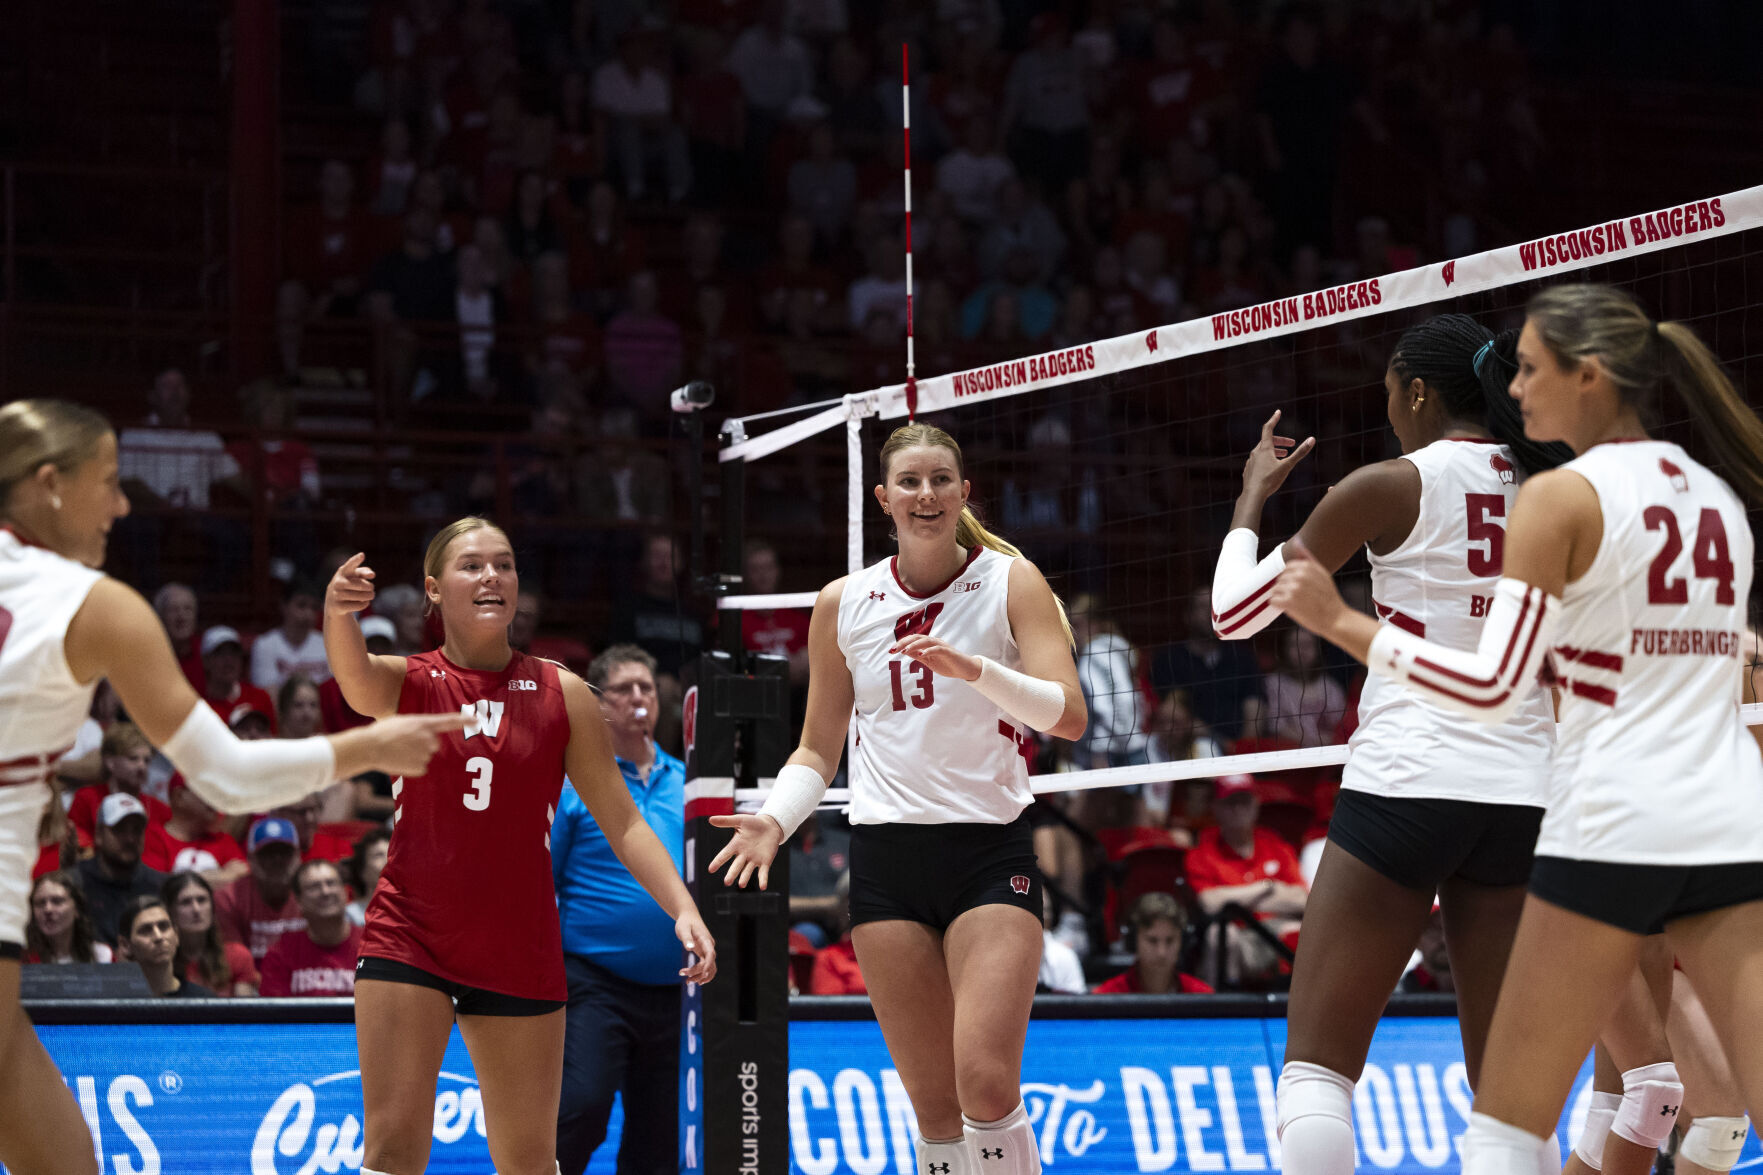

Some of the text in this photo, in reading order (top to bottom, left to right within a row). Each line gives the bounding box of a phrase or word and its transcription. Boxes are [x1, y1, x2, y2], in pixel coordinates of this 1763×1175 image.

[1519, 198, 1726, 271] WISCONSIN BADGERS
[1212, 279, 1382, 341] WISCONSIN BADGERS
[953, 345, 1095, 398] WISCONSIN BADGERS
[1465, 492, 1506, 578] 5
[1643, 505, 1735, 607] 24
[887, 660, 935, 712] 13
[462, 756, 494, 812] 3
[737, 1061, 761, 1135] sports
